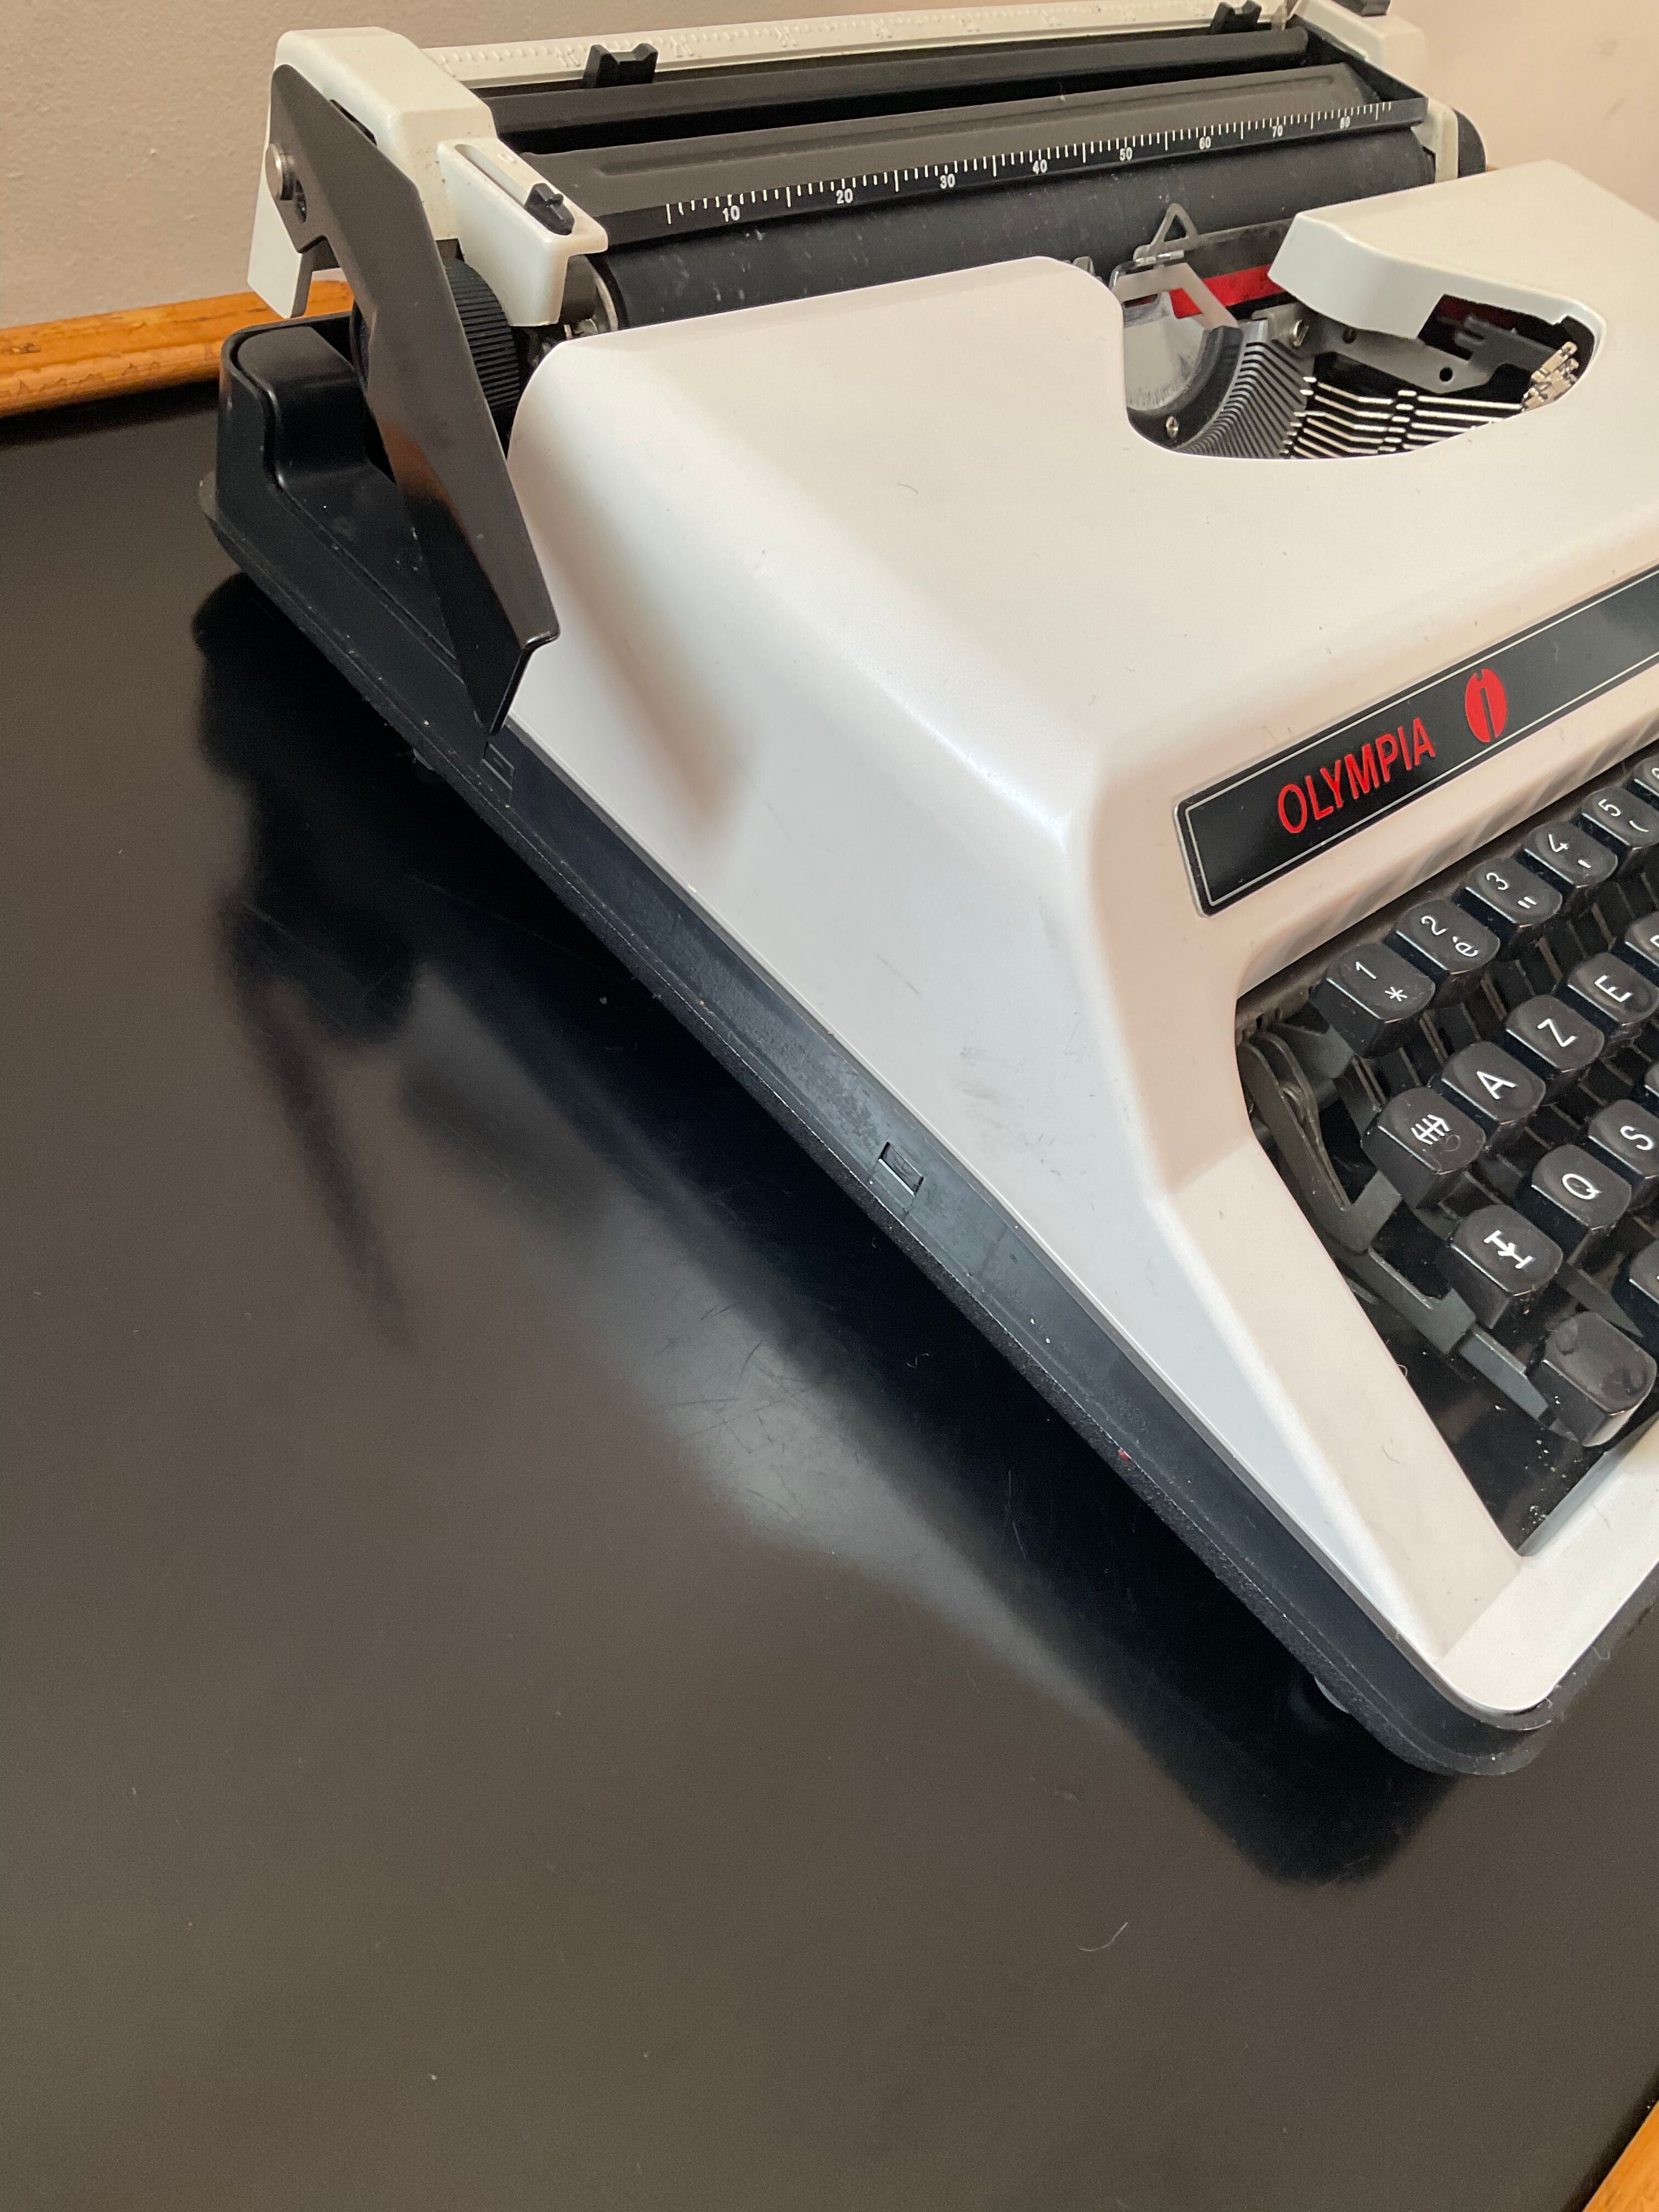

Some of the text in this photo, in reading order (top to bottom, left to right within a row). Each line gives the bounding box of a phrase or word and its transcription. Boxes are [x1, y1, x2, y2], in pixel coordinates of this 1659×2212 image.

[721, 115, 1351, 223] 10 20 30 40 50 60 70 80
[1277, 717, 1436, 833] OLYMPIA
[1598, 798, 1622, 817] 5
[1548, 833, 1569, 853] 4
[1486, 871, 1510, 891] 3
[1421, 915, 1448, 936] 2
[1355, 961, 1377, 980] 1
[1594, 975, 1632, 1003] E
[1536, 1018, 1577, 1047] Z
[1476, 1071, 1517, 1100] A
[1620, 1125, 1655, 1151] S
[1561, 1173, 1603, 1200] Q
